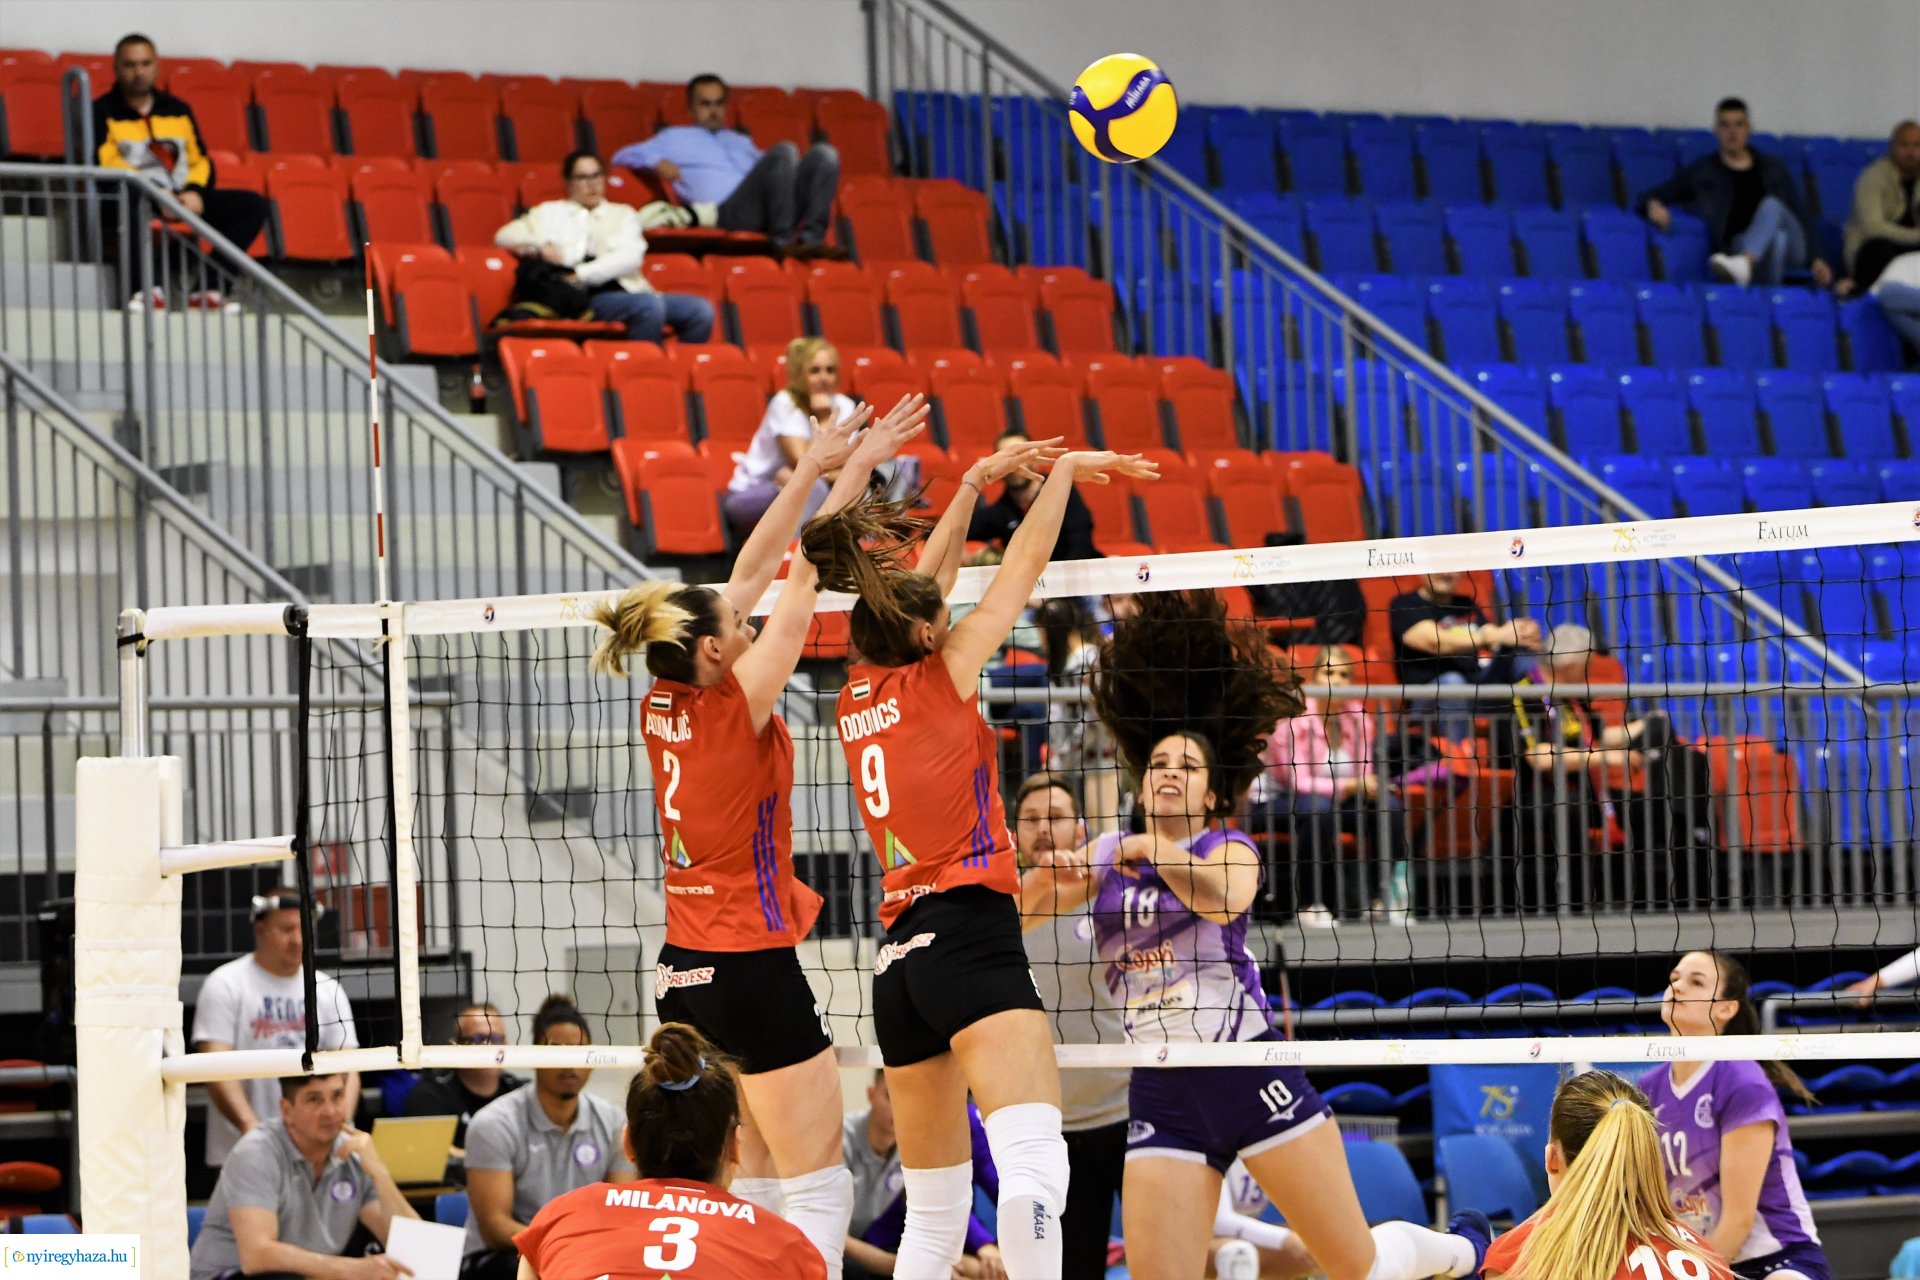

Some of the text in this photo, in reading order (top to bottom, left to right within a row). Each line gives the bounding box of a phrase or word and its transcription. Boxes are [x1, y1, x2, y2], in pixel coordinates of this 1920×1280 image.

[662, 749, 682, 821] 2
[861, 744, 892, 819] 9
[1122, 886, 1160, 929] 18
[1661, 1131, 1693, 1176] 12
[605, 1188, 756, 1225] MILANOVA
[643, 1216, 700, 1271] 3
